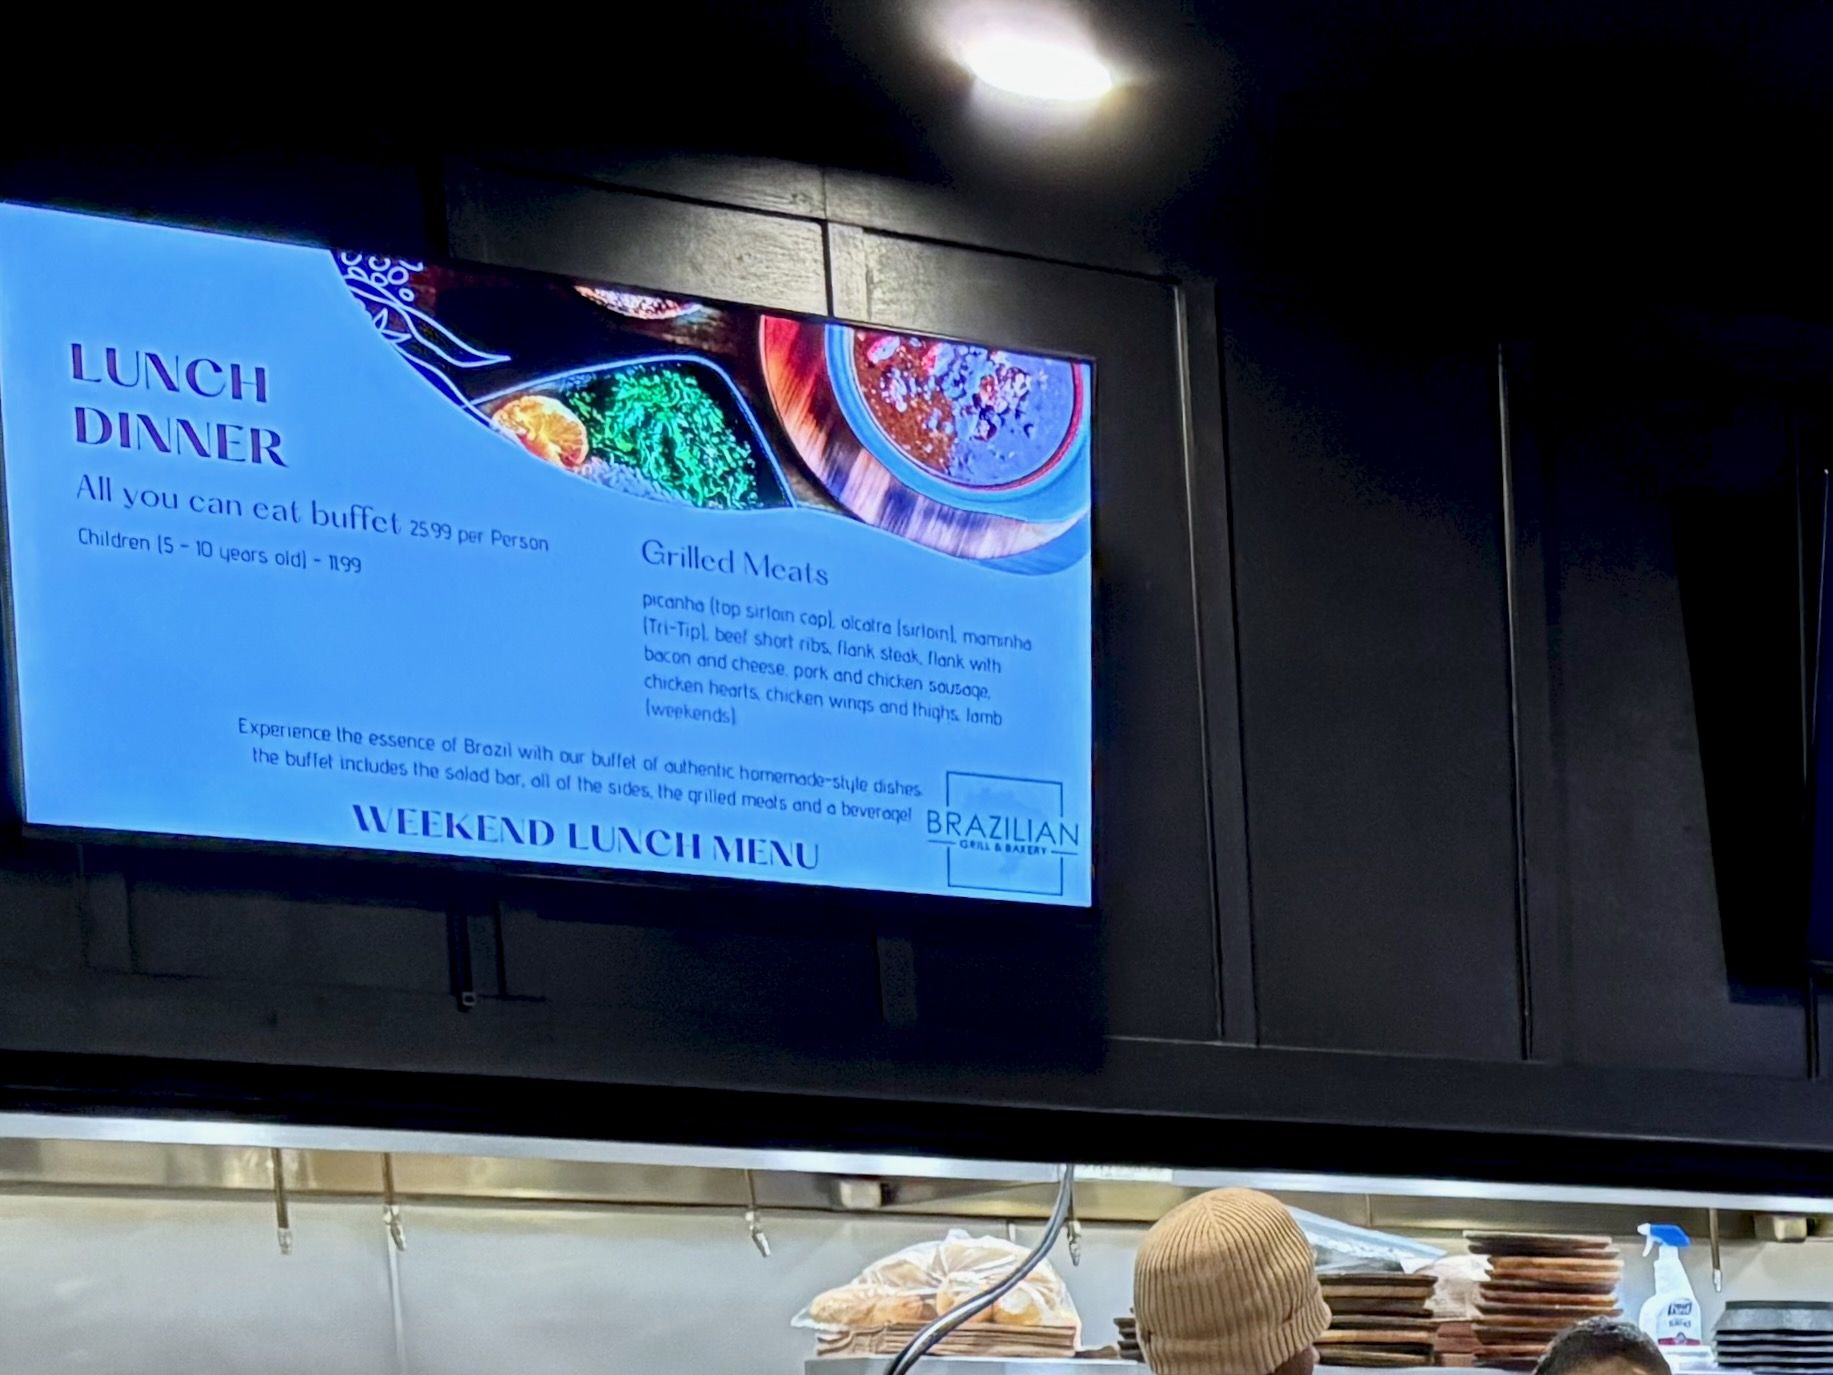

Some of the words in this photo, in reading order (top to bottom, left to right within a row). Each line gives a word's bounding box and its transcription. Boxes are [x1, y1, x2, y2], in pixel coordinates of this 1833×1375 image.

[71, 342, 268, 403] LUNCH
[74, 405, 288, 468] DINNER
[77, 474, 111, 502] All
[123, 488, 178, 510] you
[189, 496, 242, 517] can
[253, 500, 301, 524] eat
[312, 500, 401, 535] buffet
[458, 529, 483, 545] per
[491, 529, 549, 551] Person
[79, 527, 150, 552] Children
[196, 540, 213, 558] 10
[220, 547, 268, 564] years
[642, 539, 734, 574] Grilled
[744, 551, 828, 585] Meats
[643, 594, 705, 613] picanha
[746, 605, 794, 623] sirloin
[841, 615, 891, 634] alcatra
[963, 632, 1032, 652] maminha
[715, 626, 747, 644] beef
[754, 632, 794, 650] short
[838, 640, 875, 660] flank
[928, 649, 965, 669] flank
[969, 657, 1001, 674] with
[644, 645, 691, 665] bacon
[697, 654, 727, 670] and
[794, 665, 828, 681] pork
[833, 669, 862, 685] and
[867, 671, 923, 691] chicken
[644, 674, 703, 694] chicken
[766, 687, 823, 707] chicken
[829, 696, 874, 715] wings
[879, 700, 908, 716] and
[967, 707, 1002, 726] lamb
[238, 717, 331, 742] Experience
[337, 727, 363, 745] the
[369, 733, 435, 751] essence
[442, 737, 456, 753] of
[464, 737, 512, 757] Brazil
[518, 746, 553, 762] with
[560, 751, 584, 764] our
[592, 751, 636, 770] buffet
[643, 756, 658, 772] of
[664, 760, 735, 779] authentic
[739, 765, 868, 794] homemade-style
[253, 747, 279, 765] the
[285, 749, 333, 770] buffet
[340, 755, 408, 776] includes
[414, 761, 439, 779] the
[445, 765, 489, 783] salad
[531, 773, 550, 789] all
[556, 775, 571, 791] of
[578, 776, 602, 794] the
[658, 783, 683, 802] the
[688, 789, 736, 806] grilled
[742, 795, 787, 811] meats
[793, 798, 821, 814] and
[826, 803, 836, 815] a
[352, 804, 554, 847] WEEKEND
[569, 823, 701, 860] LUNCH
[713, 836, 819, 870] MENU
[927, 805, 1079, 846] BRAZILIAN
